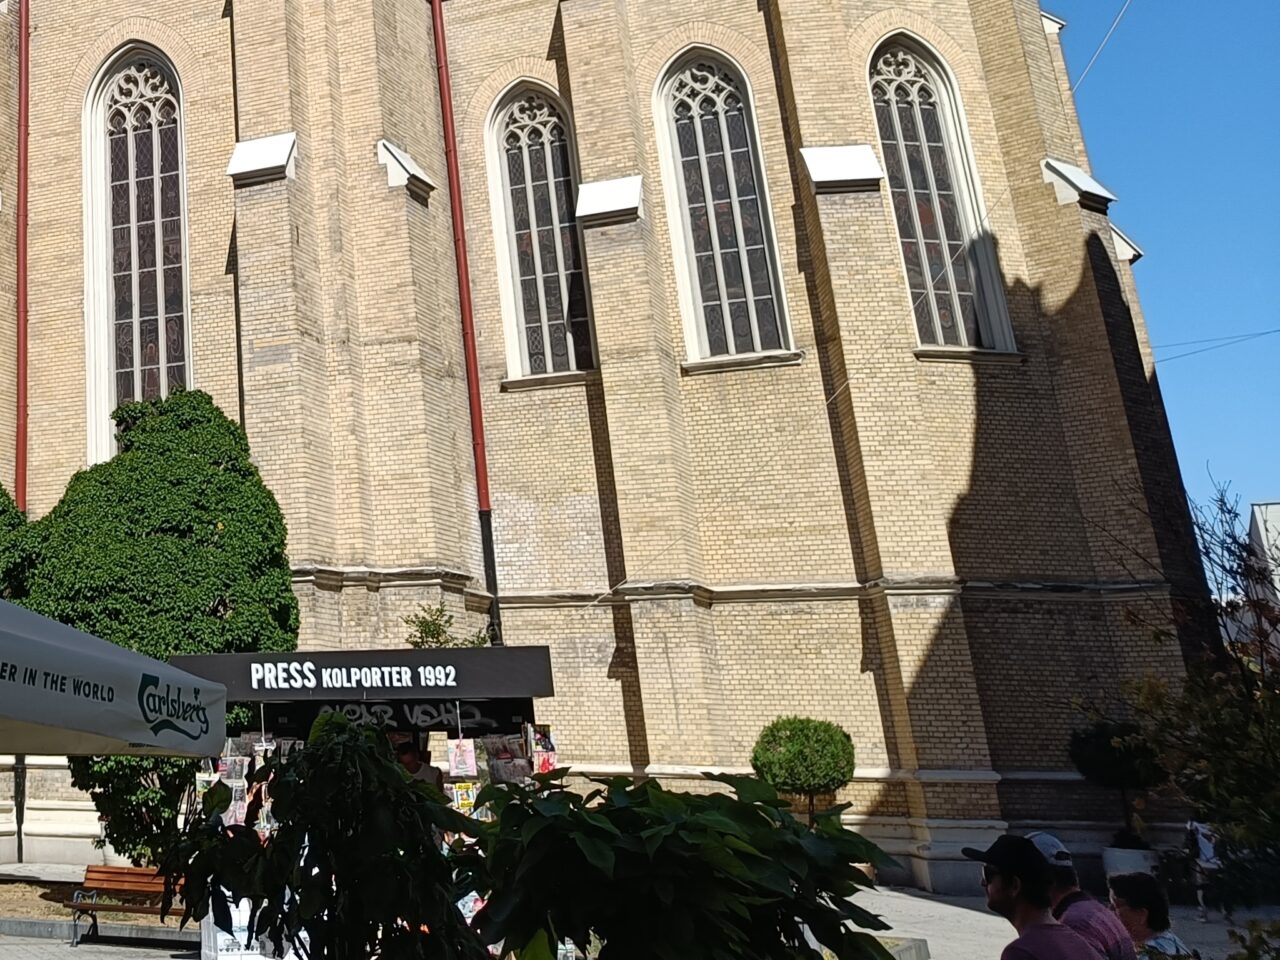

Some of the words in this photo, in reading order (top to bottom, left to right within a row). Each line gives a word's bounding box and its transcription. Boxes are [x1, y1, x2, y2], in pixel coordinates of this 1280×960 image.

[23, 666, 38, 687] IN
[43, 671, 68, 695] THE
[72, 677, 115, 704] WORLD
[251, 661, 317, 689] PRESS
[321, 666, 413, 688] KOLPORTER
[418, 665, 457, 687] 1992
[138, 673, 210, 739] Carlsberg
